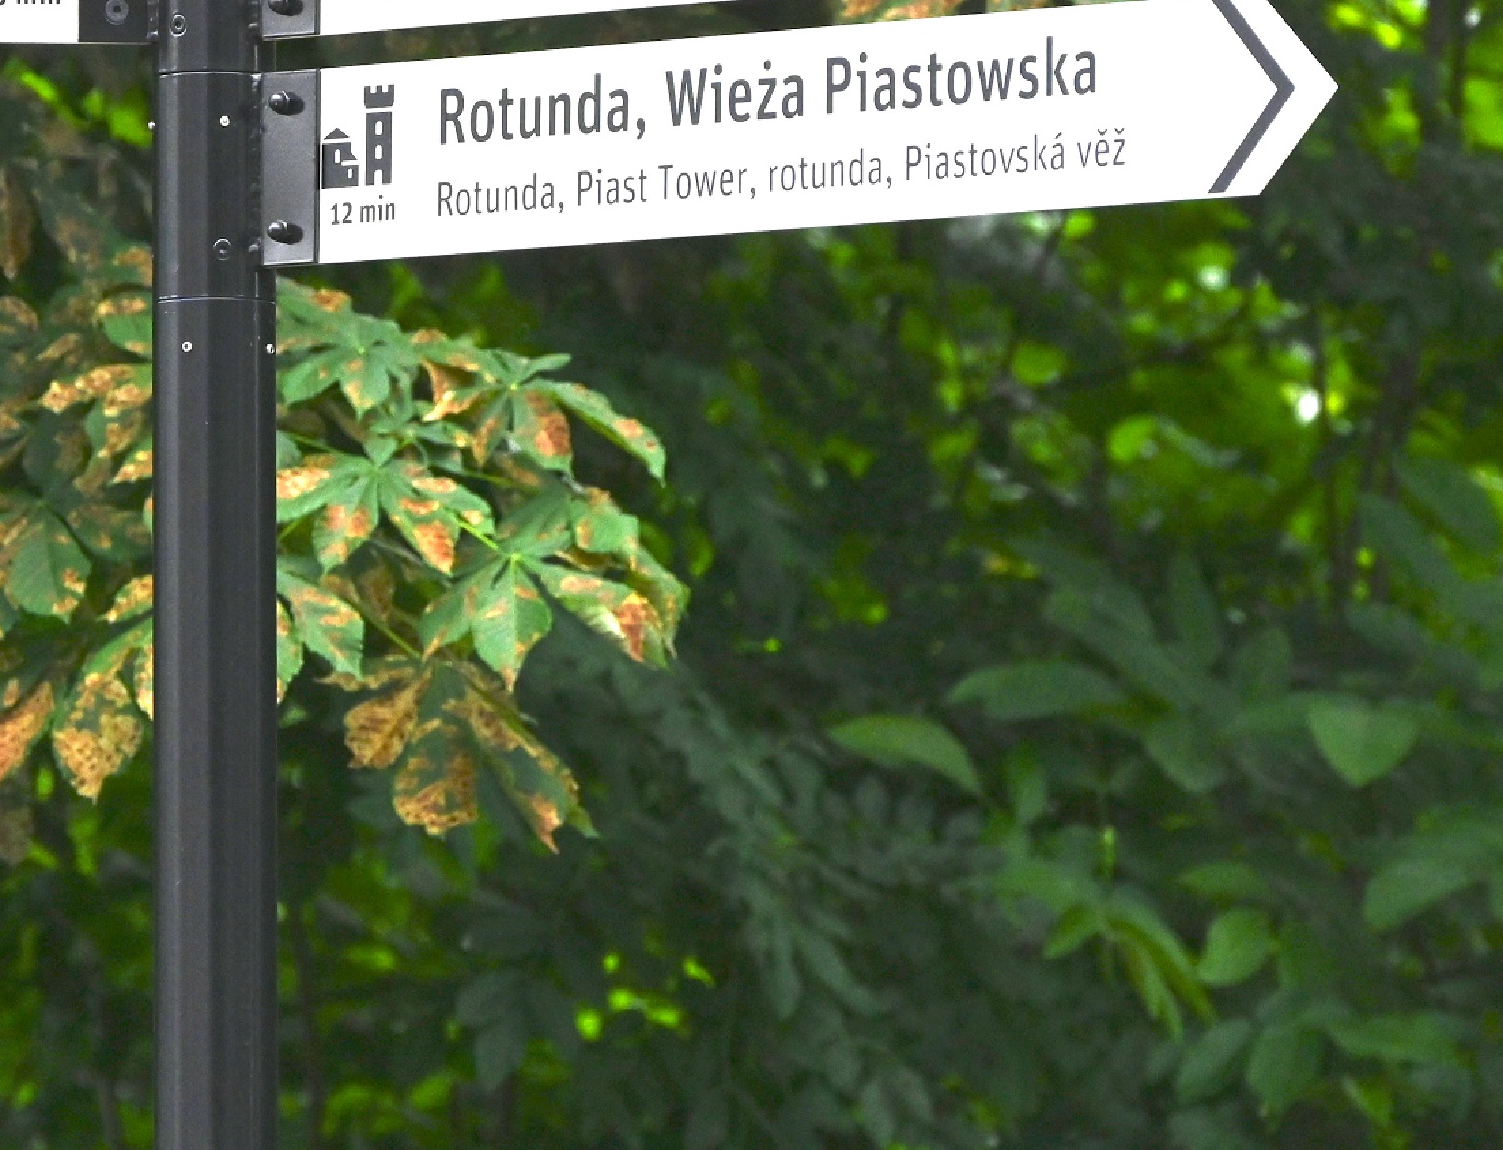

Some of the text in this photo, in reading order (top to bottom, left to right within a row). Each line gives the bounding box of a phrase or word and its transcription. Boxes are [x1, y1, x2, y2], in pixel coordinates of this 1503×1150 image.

[440, 35, 1096, 146] Rotunda, Wieża Piastowska
[331, 194, 395, 226] 12 min
[437, 127, 1126, 217] Rotunda, Piast Tower, rotunda, Piastovská věž
